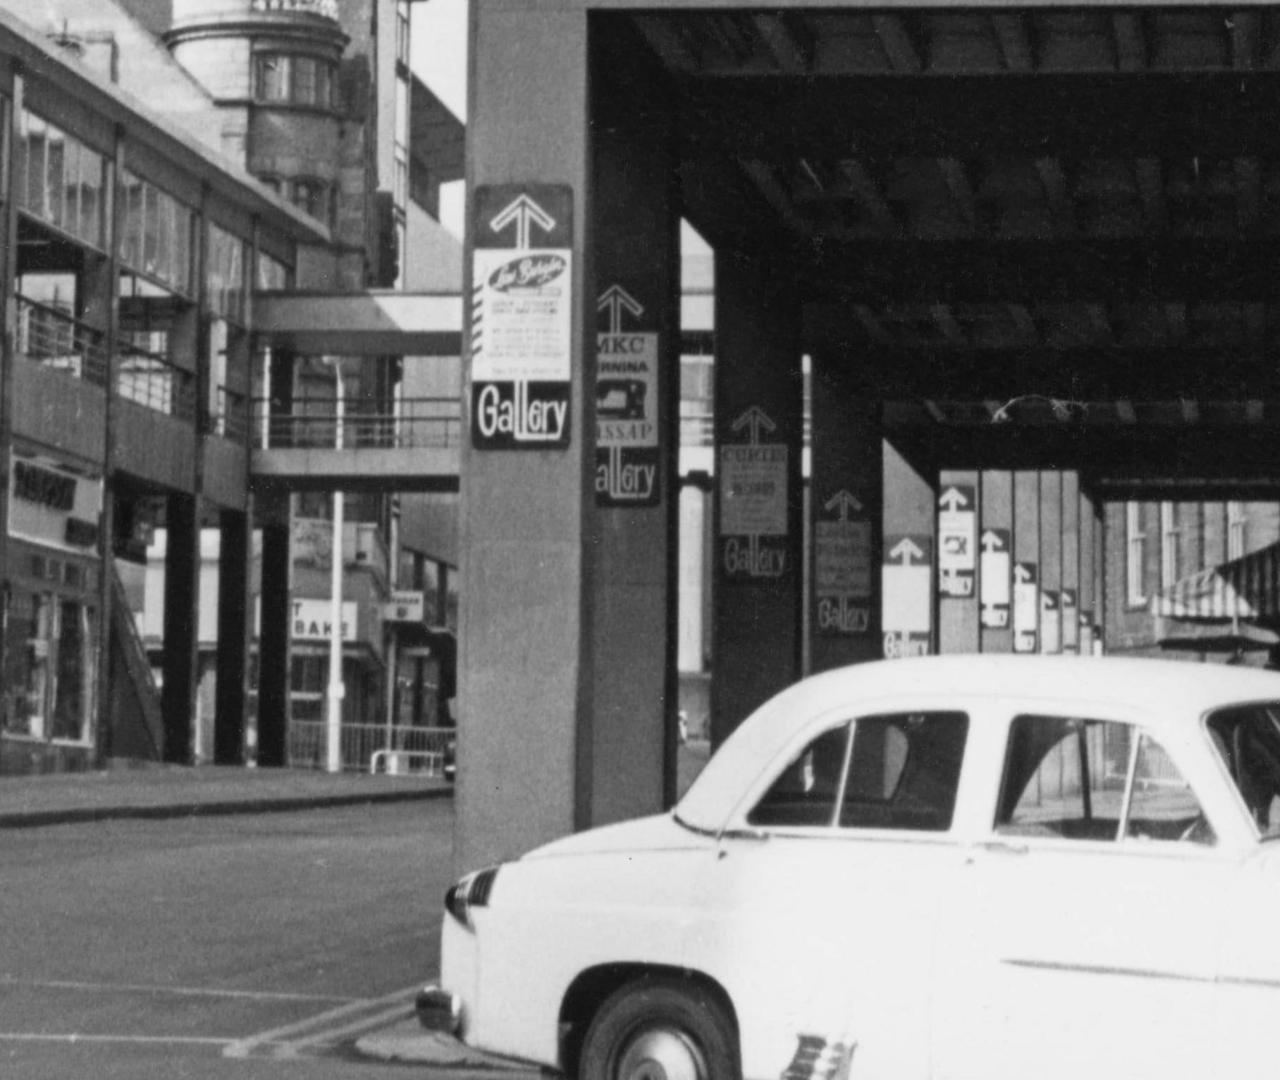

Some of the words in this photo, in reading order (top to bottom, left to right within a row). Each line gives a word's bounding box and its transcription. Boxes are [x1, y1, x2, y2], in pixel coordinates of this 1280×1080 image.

[478, 383, 567, 441] Gallery
[598, 423, 652, 440] SSAP
[595, 458, 656, 499] allery
[724, 538, 786, 576] Gallery
[818, 598, 870, 631] Gallery
